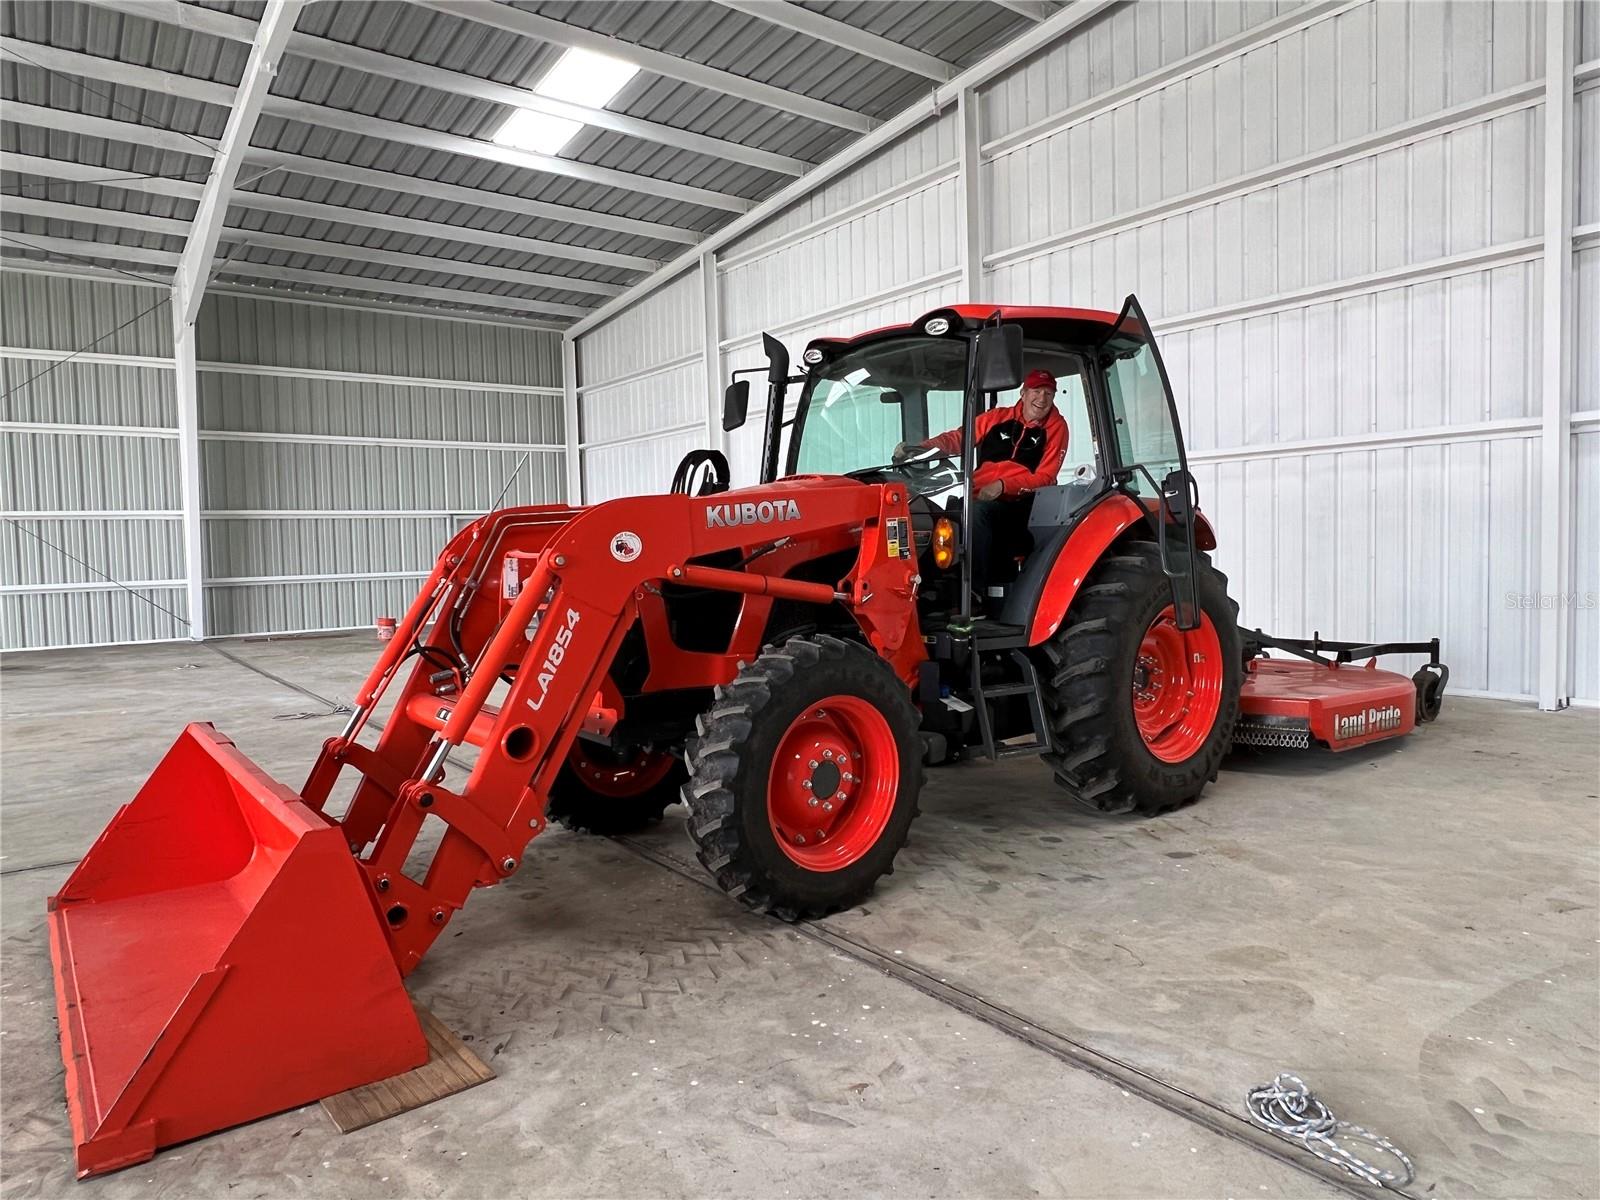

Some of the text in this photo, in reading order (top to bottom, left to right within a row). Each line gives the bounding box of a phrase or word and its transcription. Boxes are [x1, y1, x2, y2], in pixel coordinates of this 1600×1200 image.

[706, 499, 801, 528] KUBOTA
[526, 608, 581, 711] LA1854
[1334, 705, 1401, 740] Land Pride
